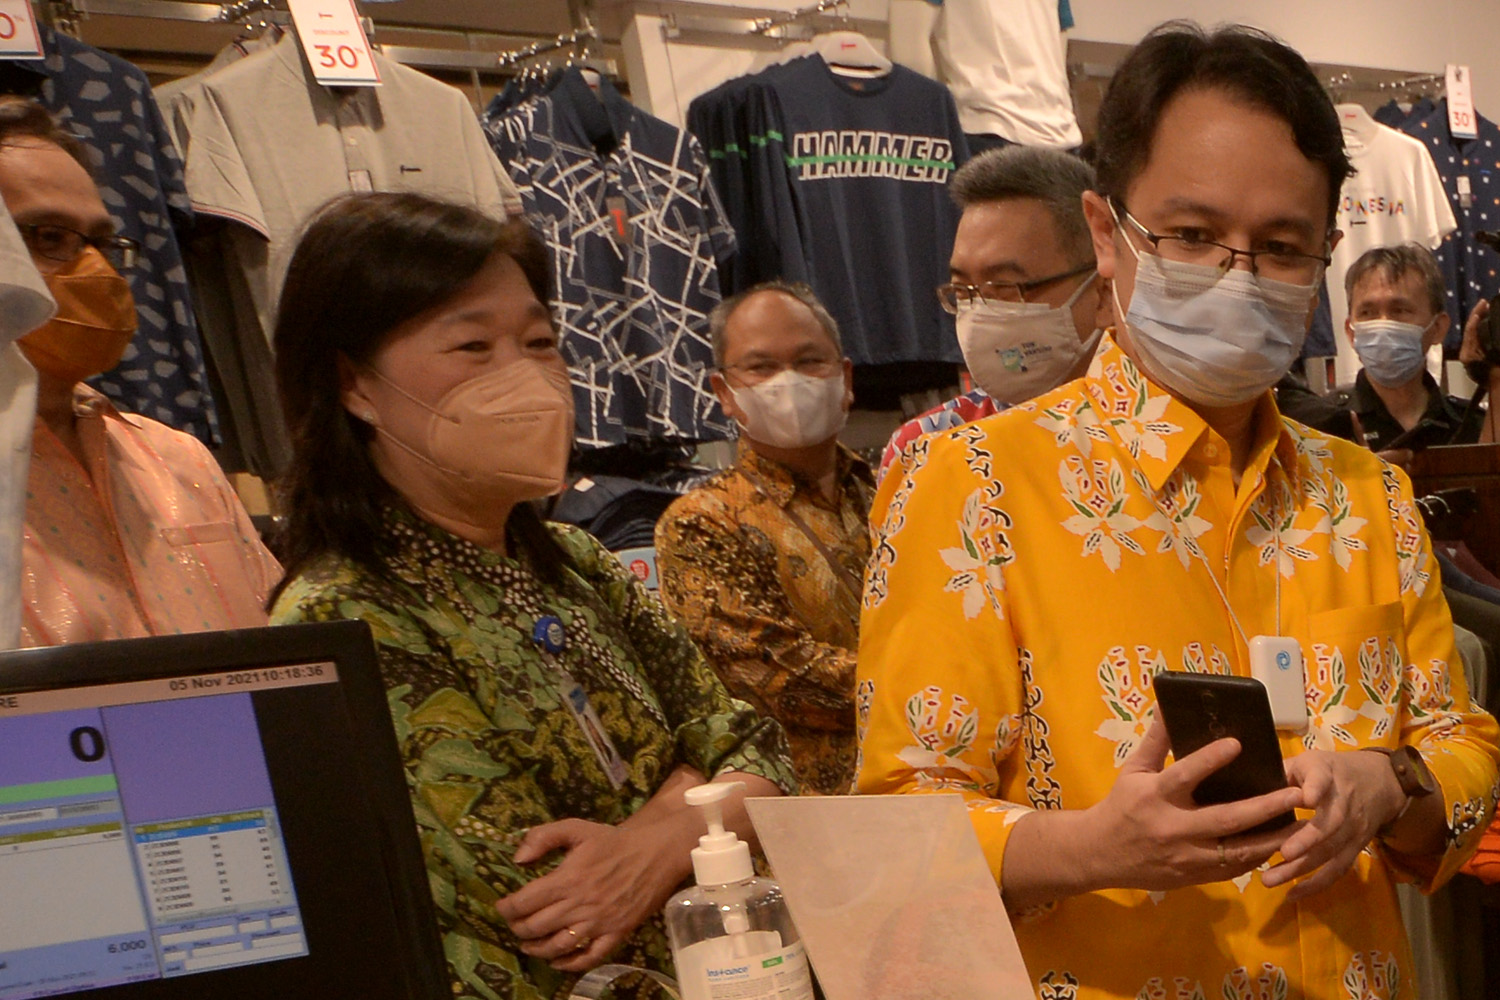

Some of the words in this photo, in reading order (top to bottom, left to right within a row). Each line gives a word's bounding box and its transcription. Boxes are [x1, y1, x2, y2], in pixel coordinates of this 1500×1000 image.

[794, 130, 953, 184] HAMMER
[1337, 196, 1407, 217] ONESIA
[169, 680, 188, 691] 05
[192, 677, 222, 689] Nov
[227, 673, 260, 686] 2021
[262, 665, 324, 682] 10:18:36
[69, 726, 106, 763] 0
